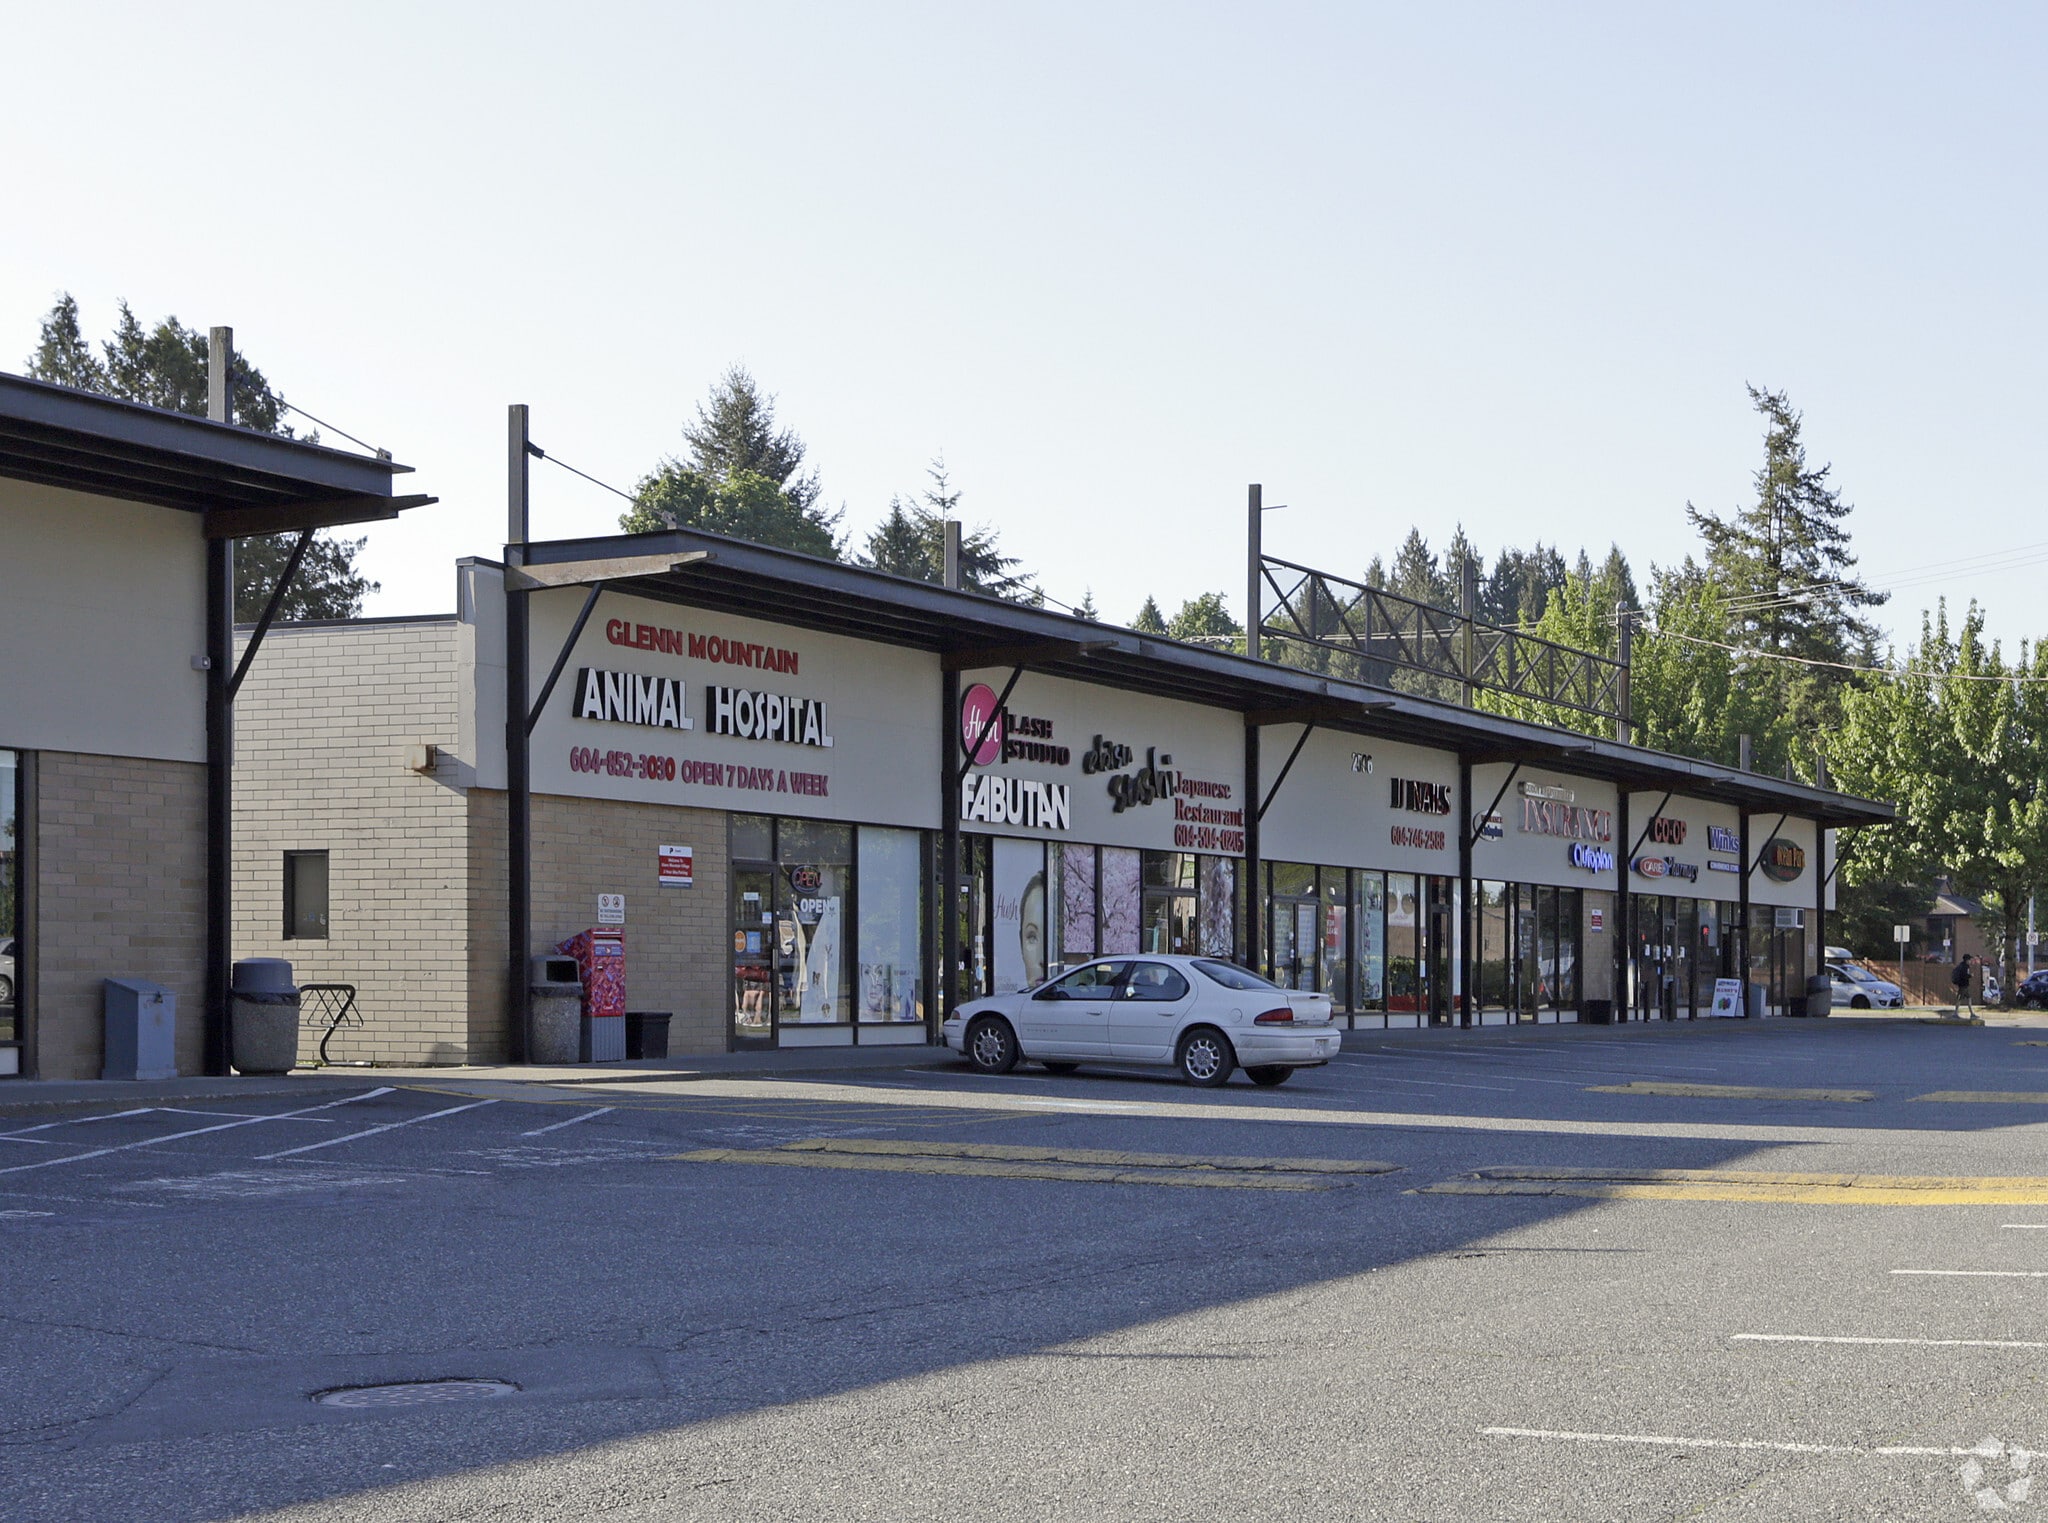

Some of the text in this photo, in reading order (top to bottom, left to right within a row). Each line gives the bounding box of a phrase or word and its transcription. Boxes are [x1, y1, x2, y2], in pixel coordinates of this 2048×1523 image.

[606, 618, 799, 675] GLENN MOUNTAIN
[573, 667, 835, 748] ANIMAL HOSPITAL
[1008, 714, 1054, 740] LASH
[1007, 739, 1070, 766] STUDIO
[569, 746, 829, 797] 604-852-3030 OPEN 7 DAYS A WEEK
[1173, 770, 1232, 800] Japanese
[961, 772, 1071, 831] FABUTAN
[1174, 797, 1245, 828] Restaurant
[1405, 779, 1452, 816] NAILS
[1652, 817, 1688, 846] CO-OP
[1709, 826, 1739, 854] Winks
[794, 871, 823, 888] OPEN
[800, 897, 830, 914] OPEN
